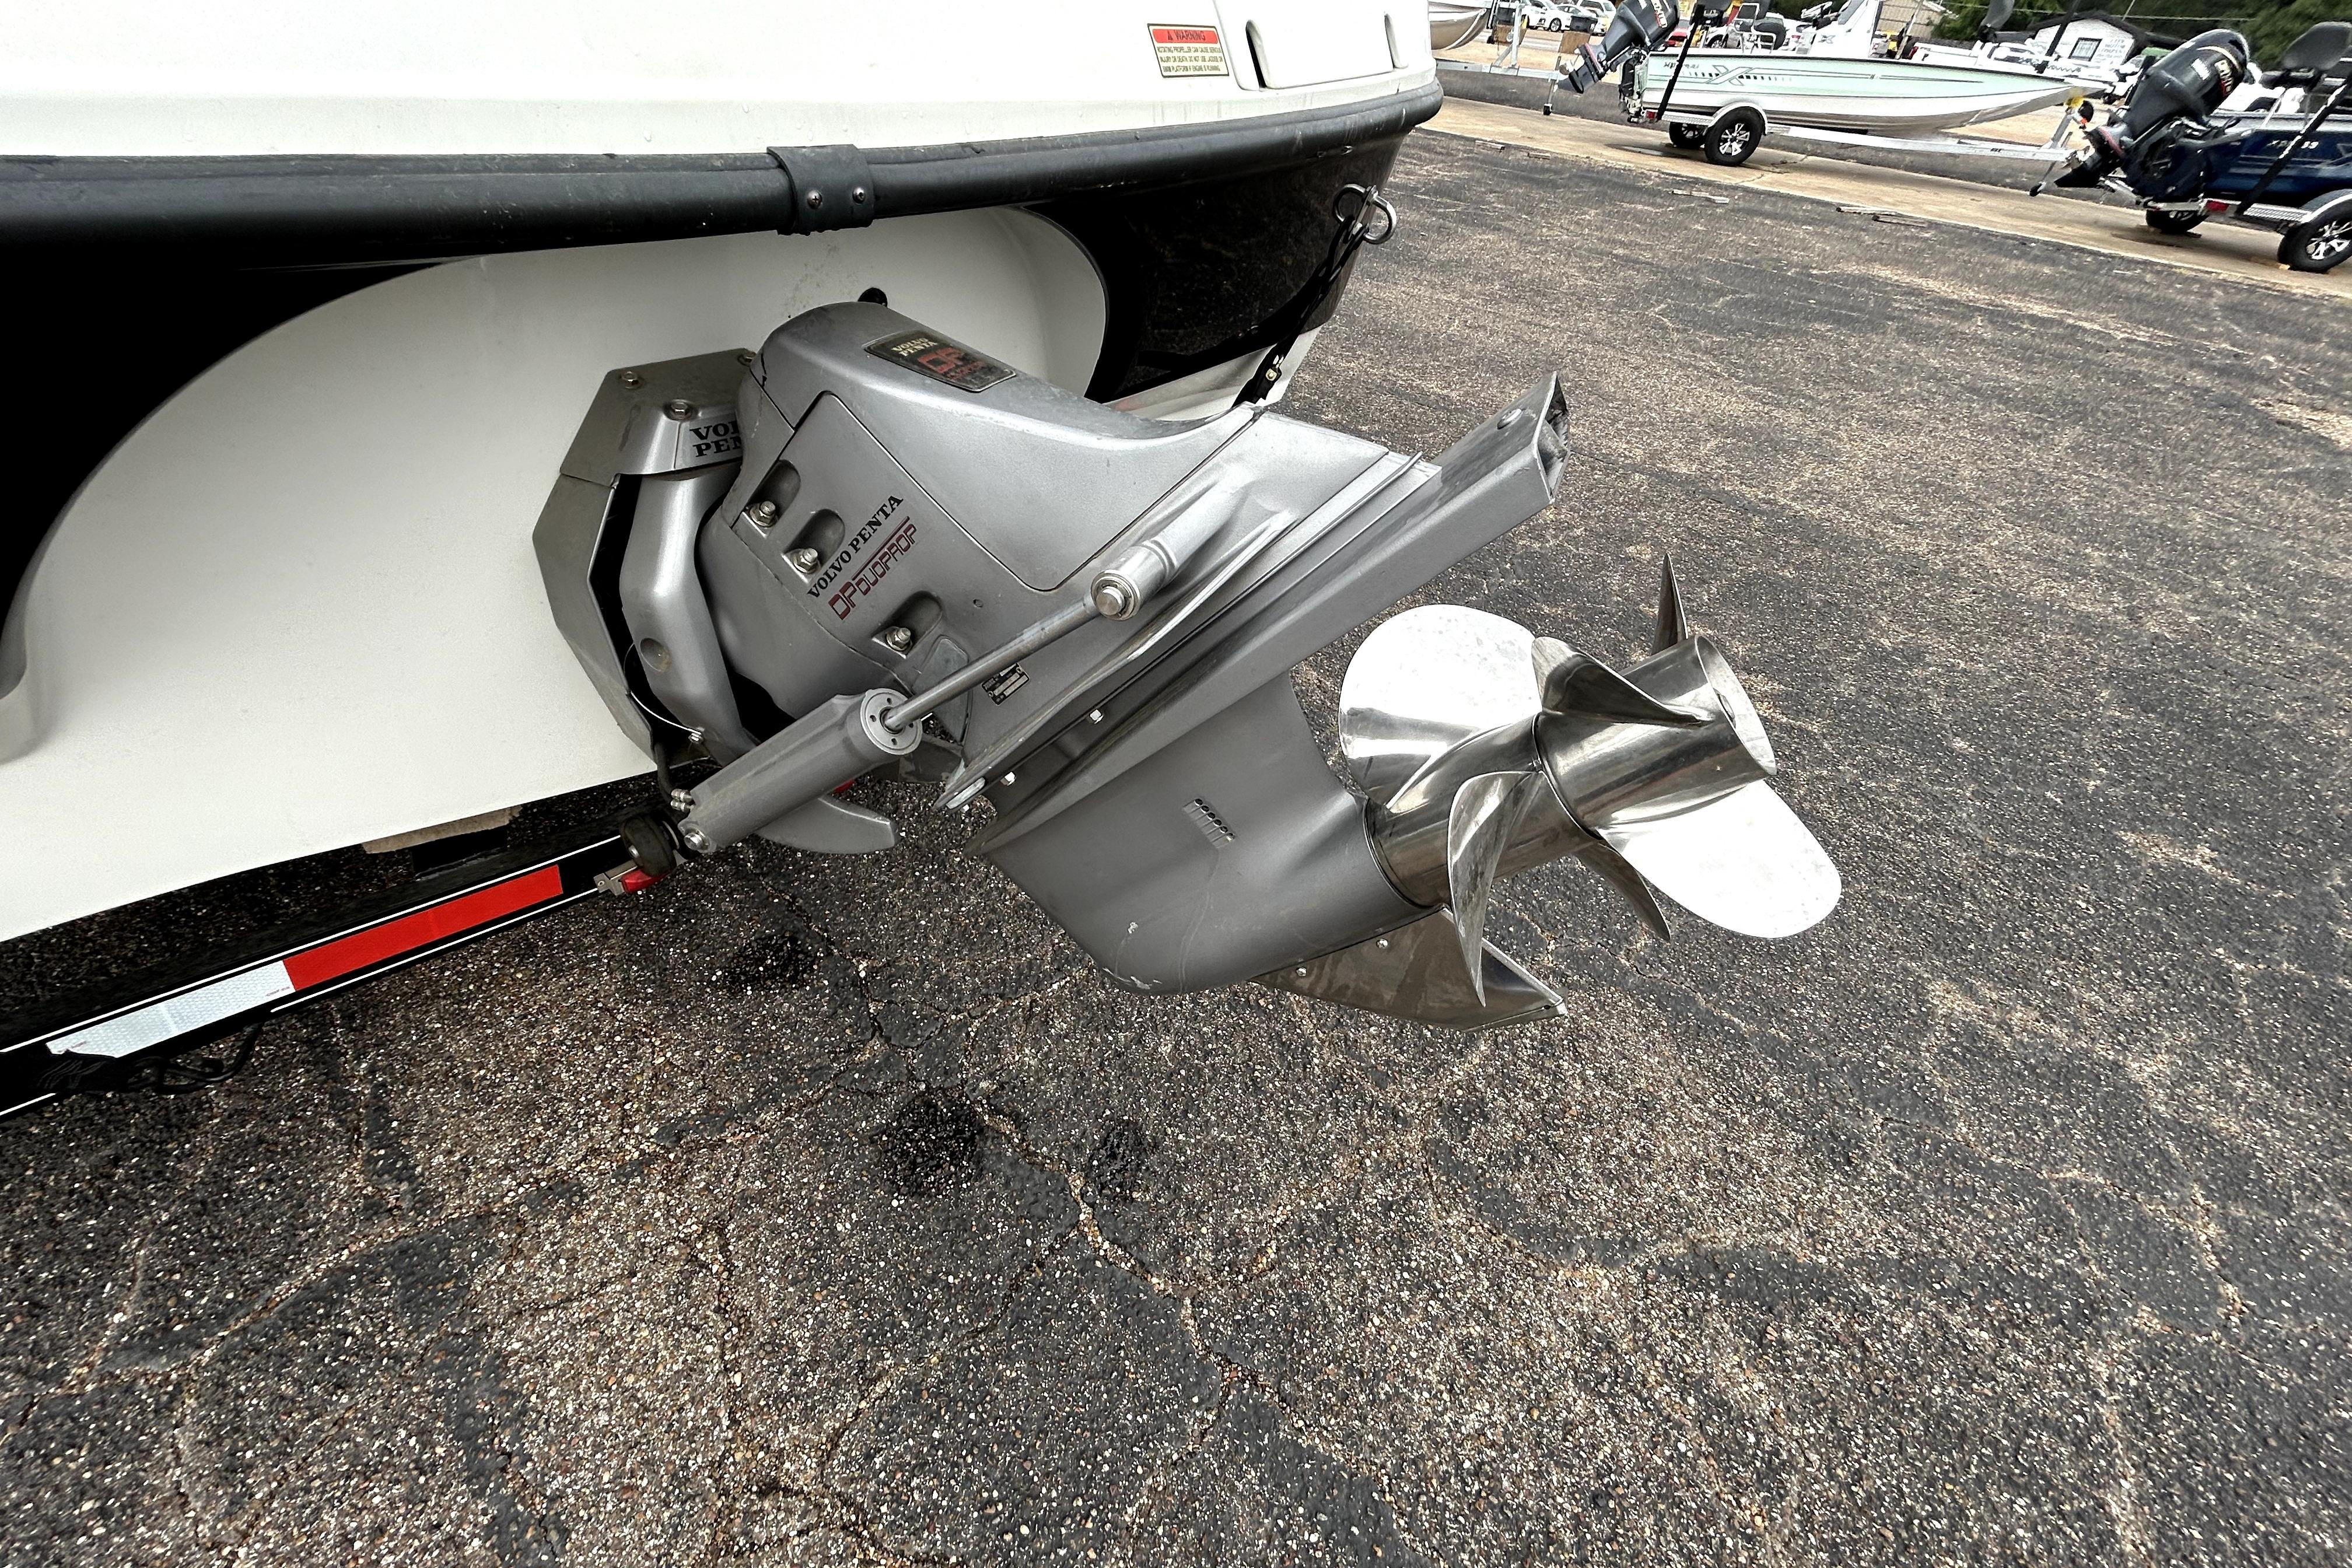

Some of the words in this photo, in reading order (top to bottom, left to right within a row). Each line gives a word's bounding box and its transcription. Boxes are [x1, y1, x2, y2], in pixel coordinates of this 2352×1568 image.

[1175, 29, 1206, 41] WARNING
[891, 338, 929, 351] VOLVO
[899, 341, 938, 356] PENTA
[807, 550, 852, 598] VOLVO
[848, 495, 904, 554] PENTA
